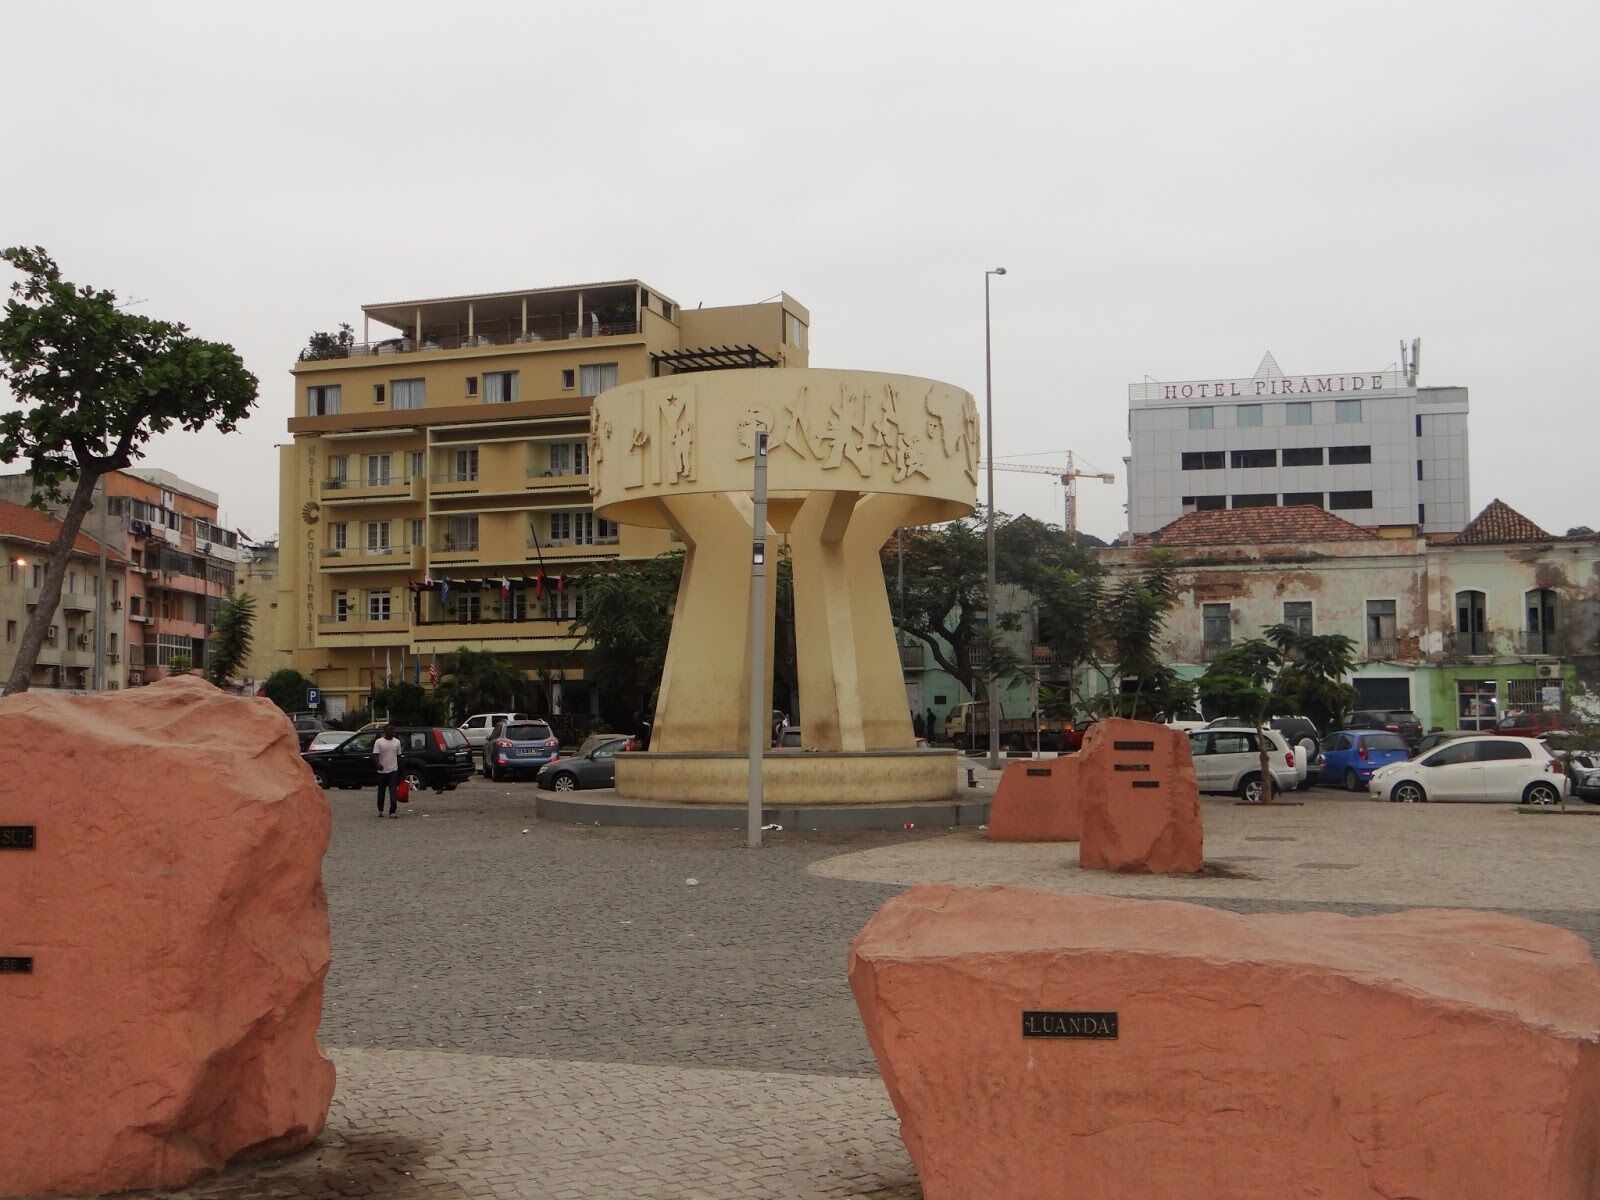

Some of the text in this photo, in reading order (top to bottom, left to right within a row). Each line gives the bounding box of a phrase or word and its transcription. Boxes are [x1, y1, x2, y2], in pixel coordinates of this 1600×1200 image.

[1164, 382, 1241, 399] HOTEL
[306, 529, 315, 644] Continental
[310, 690, 317, 701] P
[2, 830, 31, 845] SUL
[1029, 1016, 1110, 1034] LUANDA
